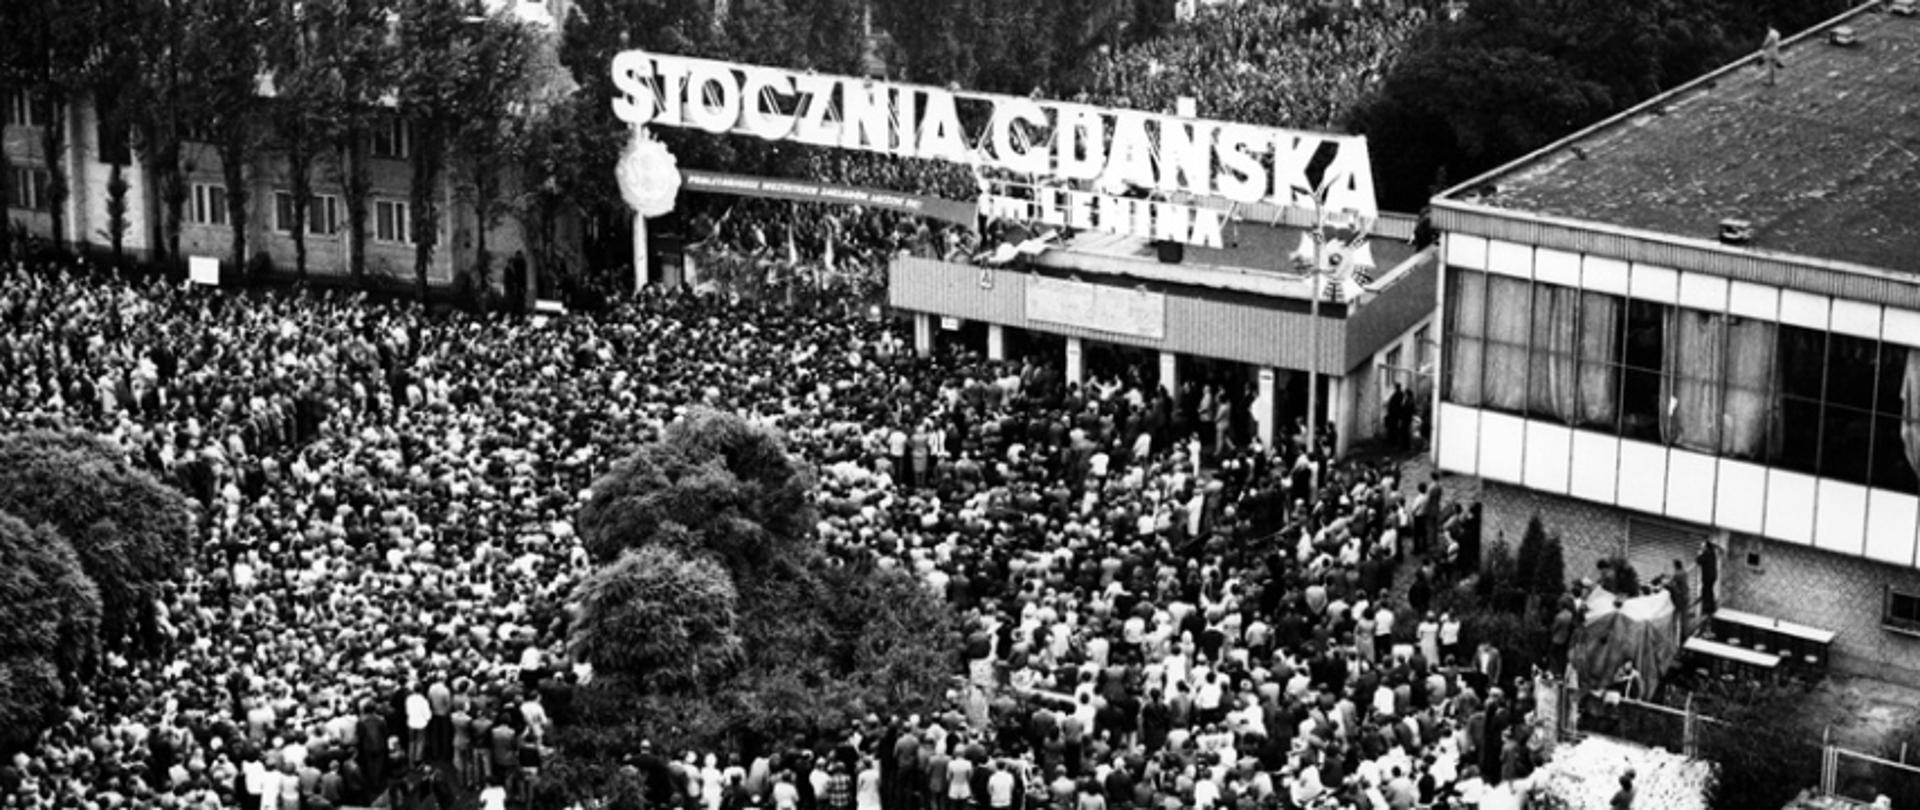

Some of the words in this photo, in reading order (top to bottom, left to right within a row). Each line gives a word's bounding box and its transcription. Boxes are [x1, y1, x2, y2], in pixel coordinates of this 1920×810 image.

[611, 49, 973, 163] STOCZNIA
[992, 96, 1378, 218] GDAŃSKA
[1042, 187, 1223, 249] LENINA
